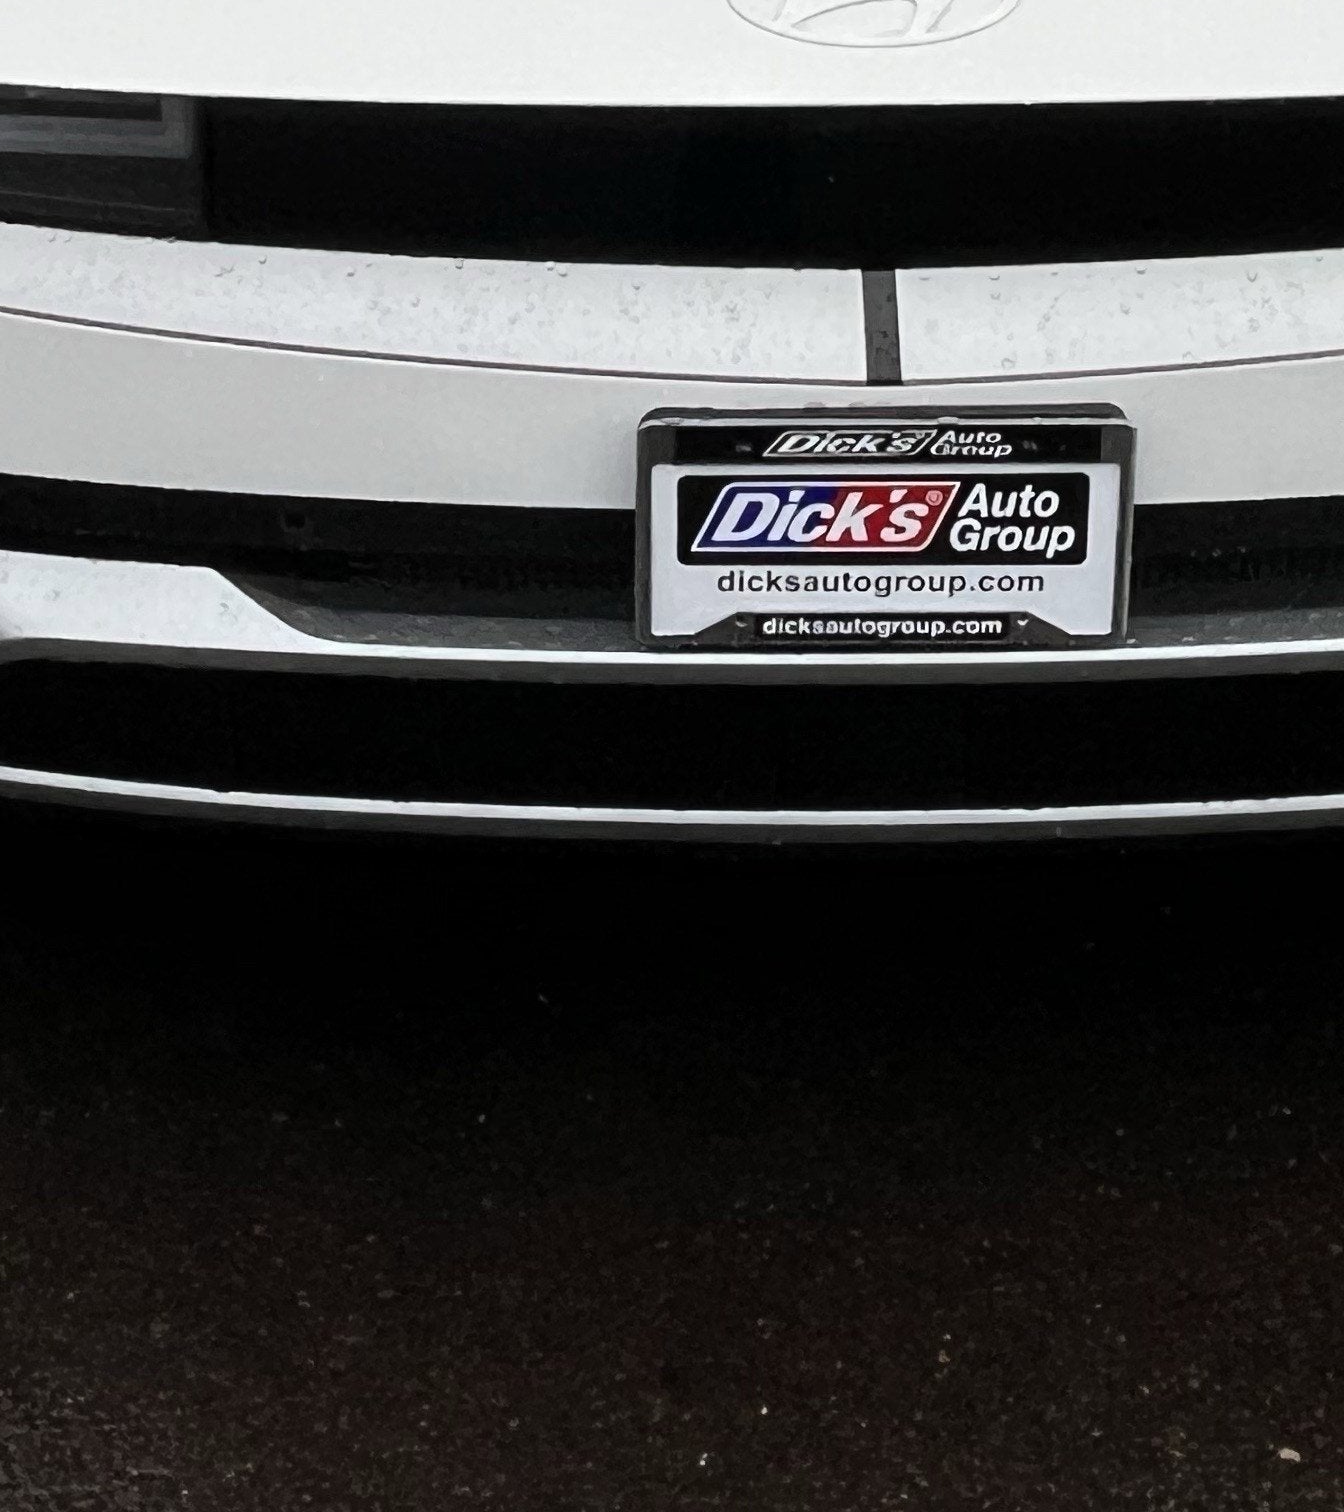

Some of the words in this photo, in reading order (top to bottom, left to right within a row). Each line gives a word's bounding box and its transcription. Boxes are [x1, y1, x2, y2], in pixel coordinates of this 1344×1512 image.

[775, 430, 919, 455] Dick's
[938, 430, 1002, 445] Auto
[929, 442, 1013, 459] Group
[710, 488, 930, 543] Dick's
[957, 482, 1060, 519] Auto
[948, 519, 1076, 559] Group
[716, 570, 1045, 597] dicksautogroup.com
[762, 617, 1003, 638] dicksautogroup.com
